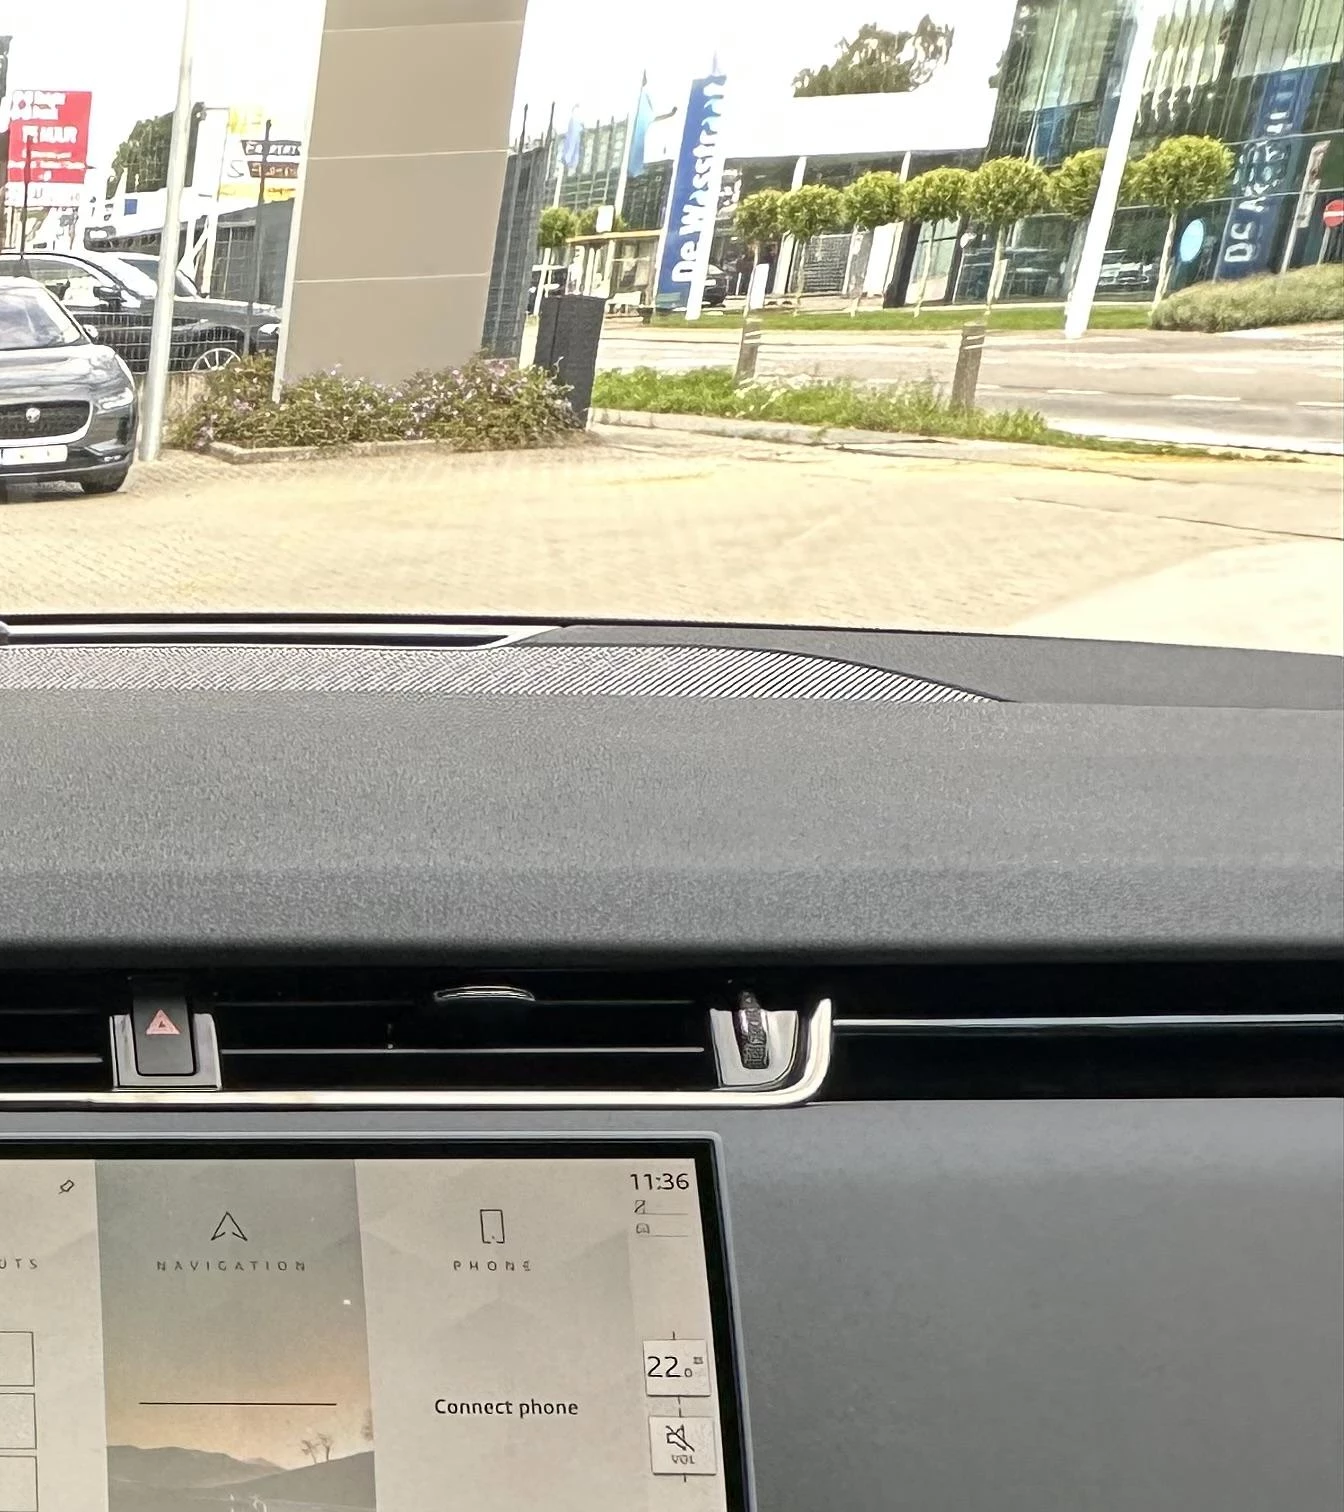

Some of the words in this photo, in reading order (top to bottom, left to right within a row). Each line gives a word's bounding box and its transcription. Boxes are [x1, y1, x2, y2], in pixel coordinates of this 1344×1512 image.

[671, 241, 700, 283] De
[630, 1172, 690, 1191] 11:36
[156, 1260, 306, 1272] NAVIGATION
[453, 1260, 532, 1272] PHONE
[434, 1398, 513, 1415] Connect
[519, 1398, 579, 1419] phone
[671, 1454, 696, 1465] VOL
